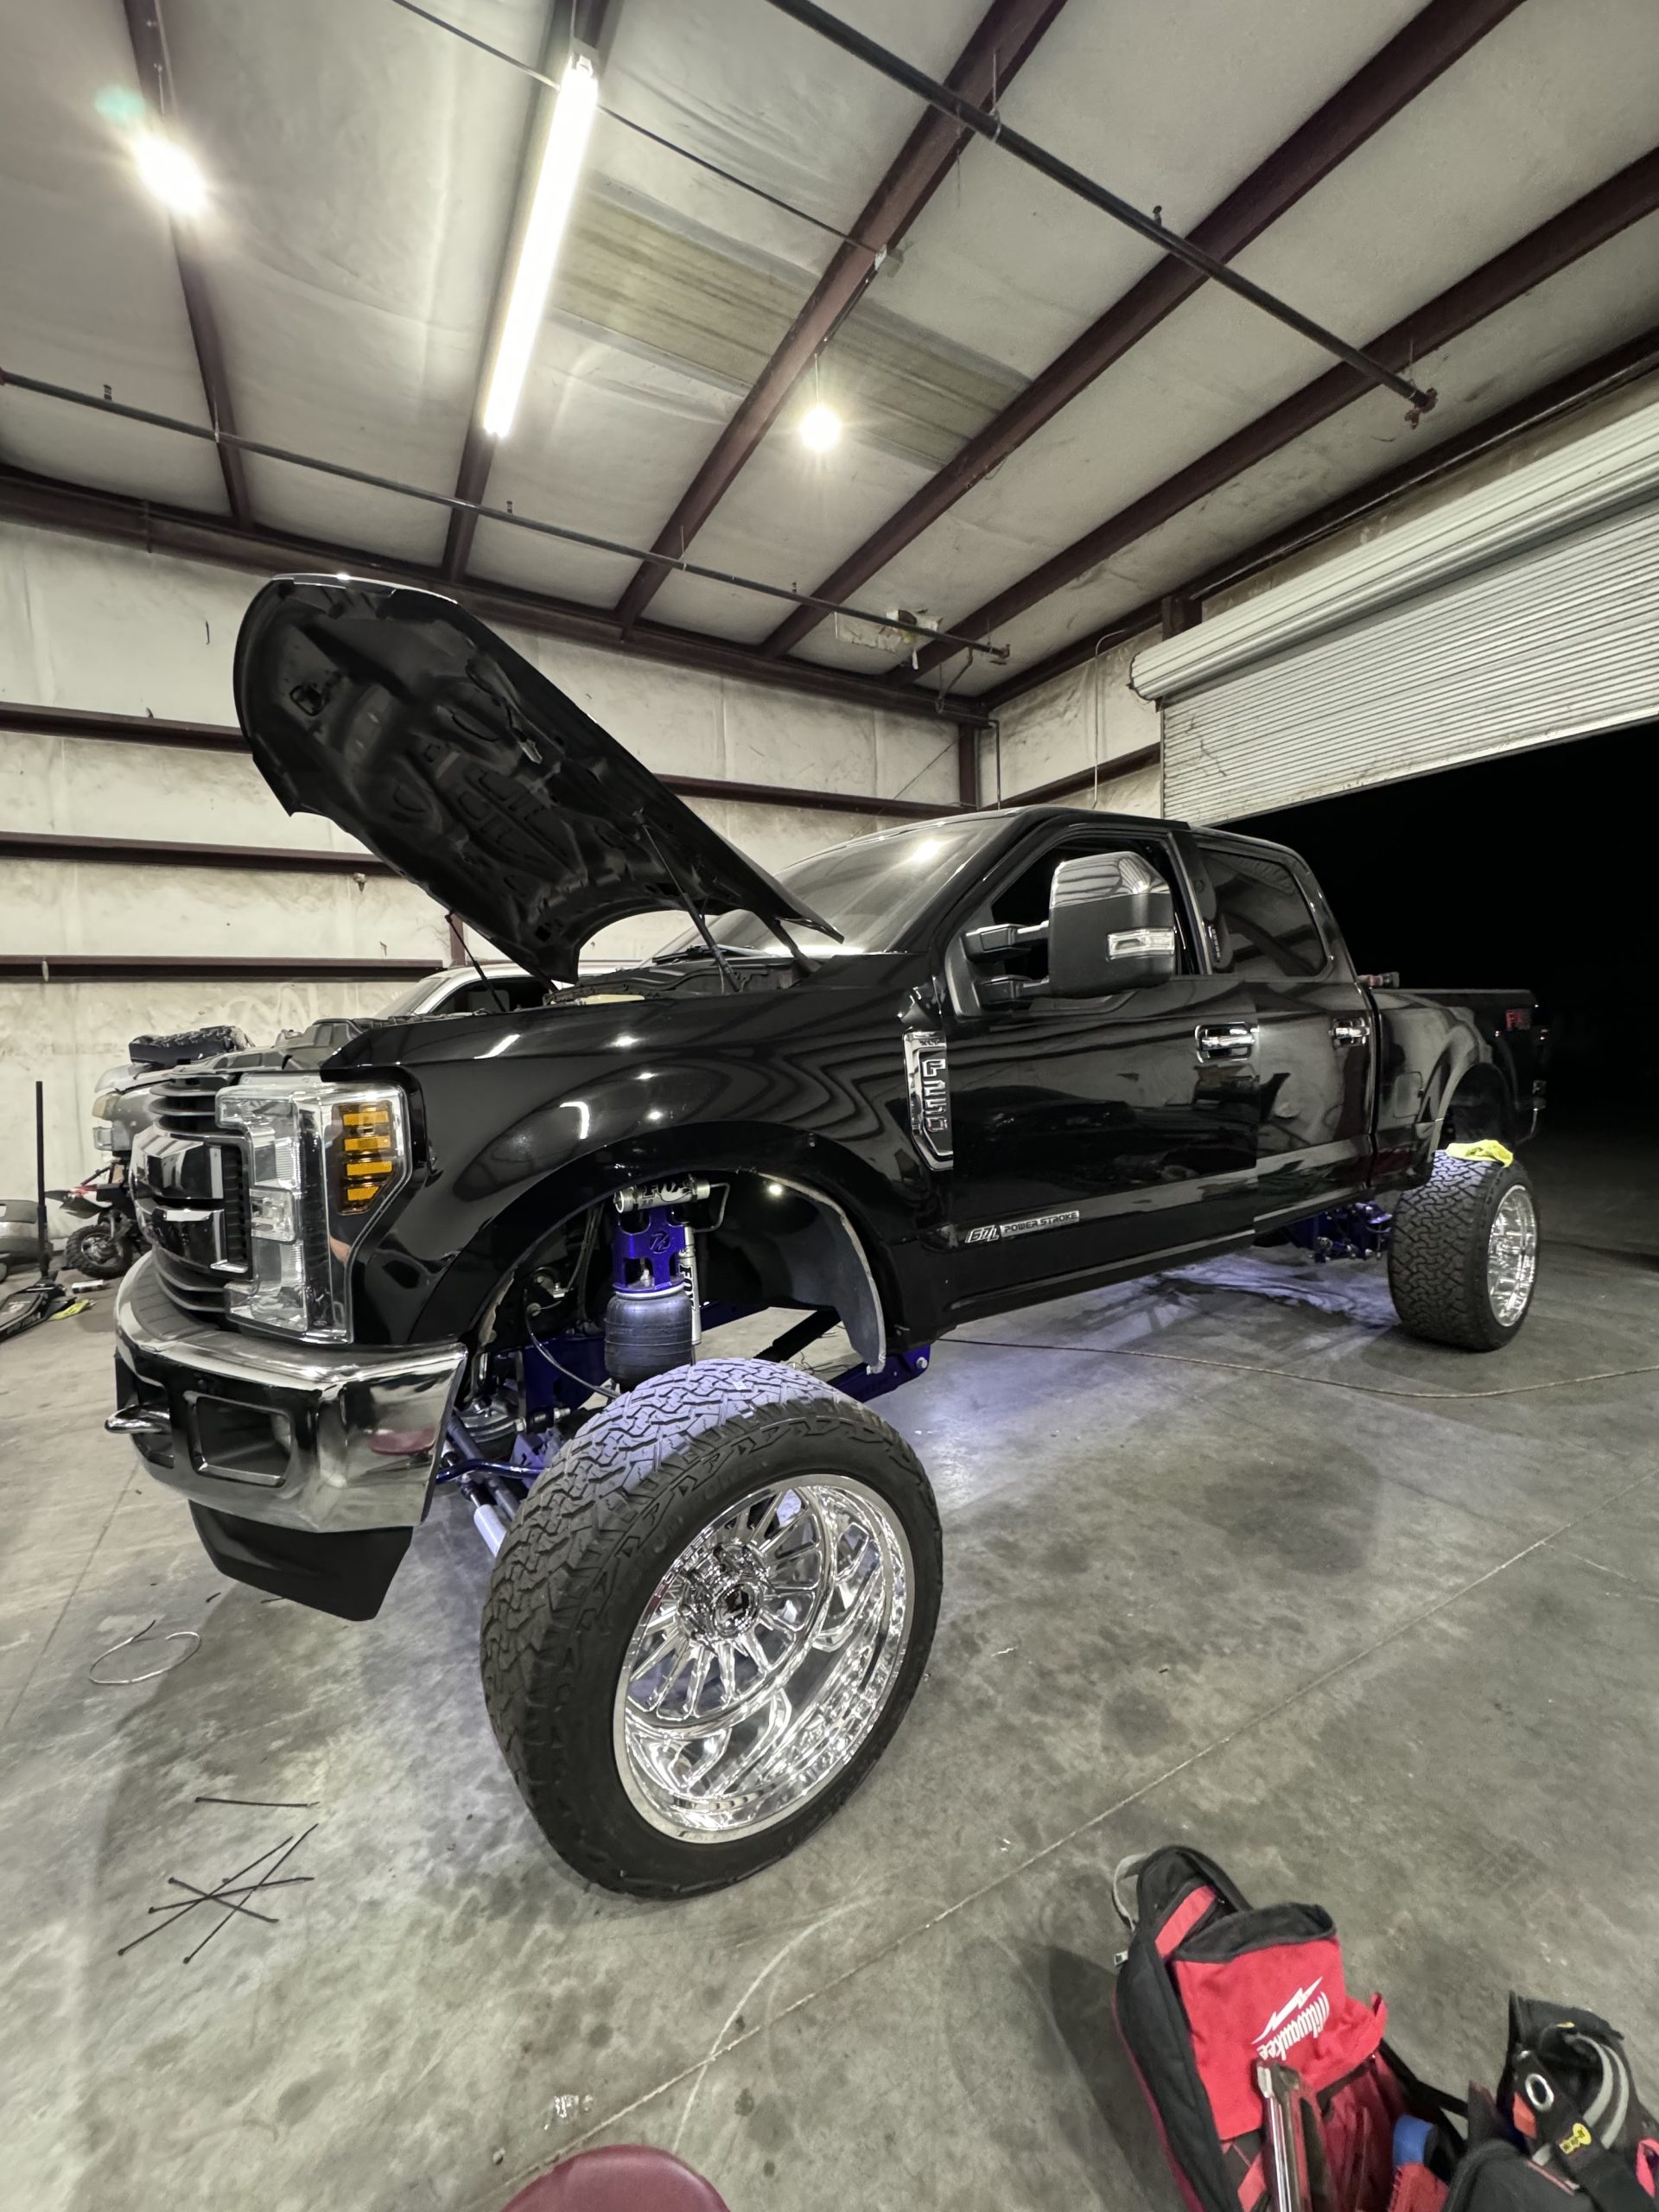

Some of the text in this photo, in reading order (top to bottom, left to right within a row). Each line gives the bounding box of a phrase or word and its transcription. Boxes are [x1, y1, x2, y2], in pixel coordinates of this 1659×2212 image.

[1004, 1220, 1038, 1234] POWER
[1039, 1212, 1077, 1226] STROKE
[1256, 1991, 1330, 2061] Milwaukee
